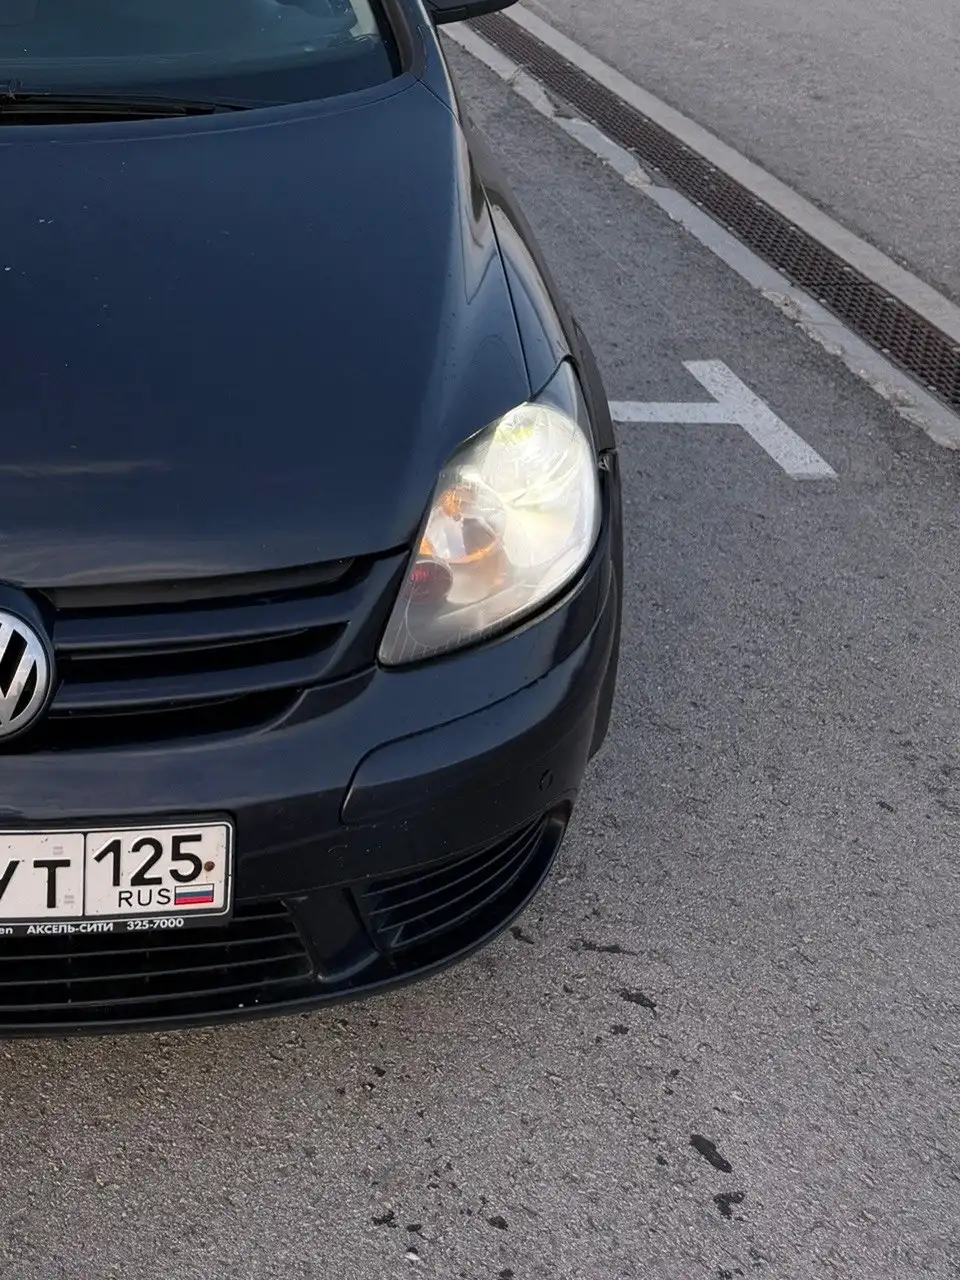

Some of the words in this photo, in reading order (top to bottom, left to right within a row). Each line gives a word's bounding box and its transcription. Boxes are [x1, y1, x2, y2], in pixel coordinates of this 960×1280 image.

[93, 834, 203, 887] 125
[117, 888, 172, 908] RUS
[26, 922, 115, 935] АКСЕЛЬ-СИТИ
[126, 917, 185, 931] 325-7000
